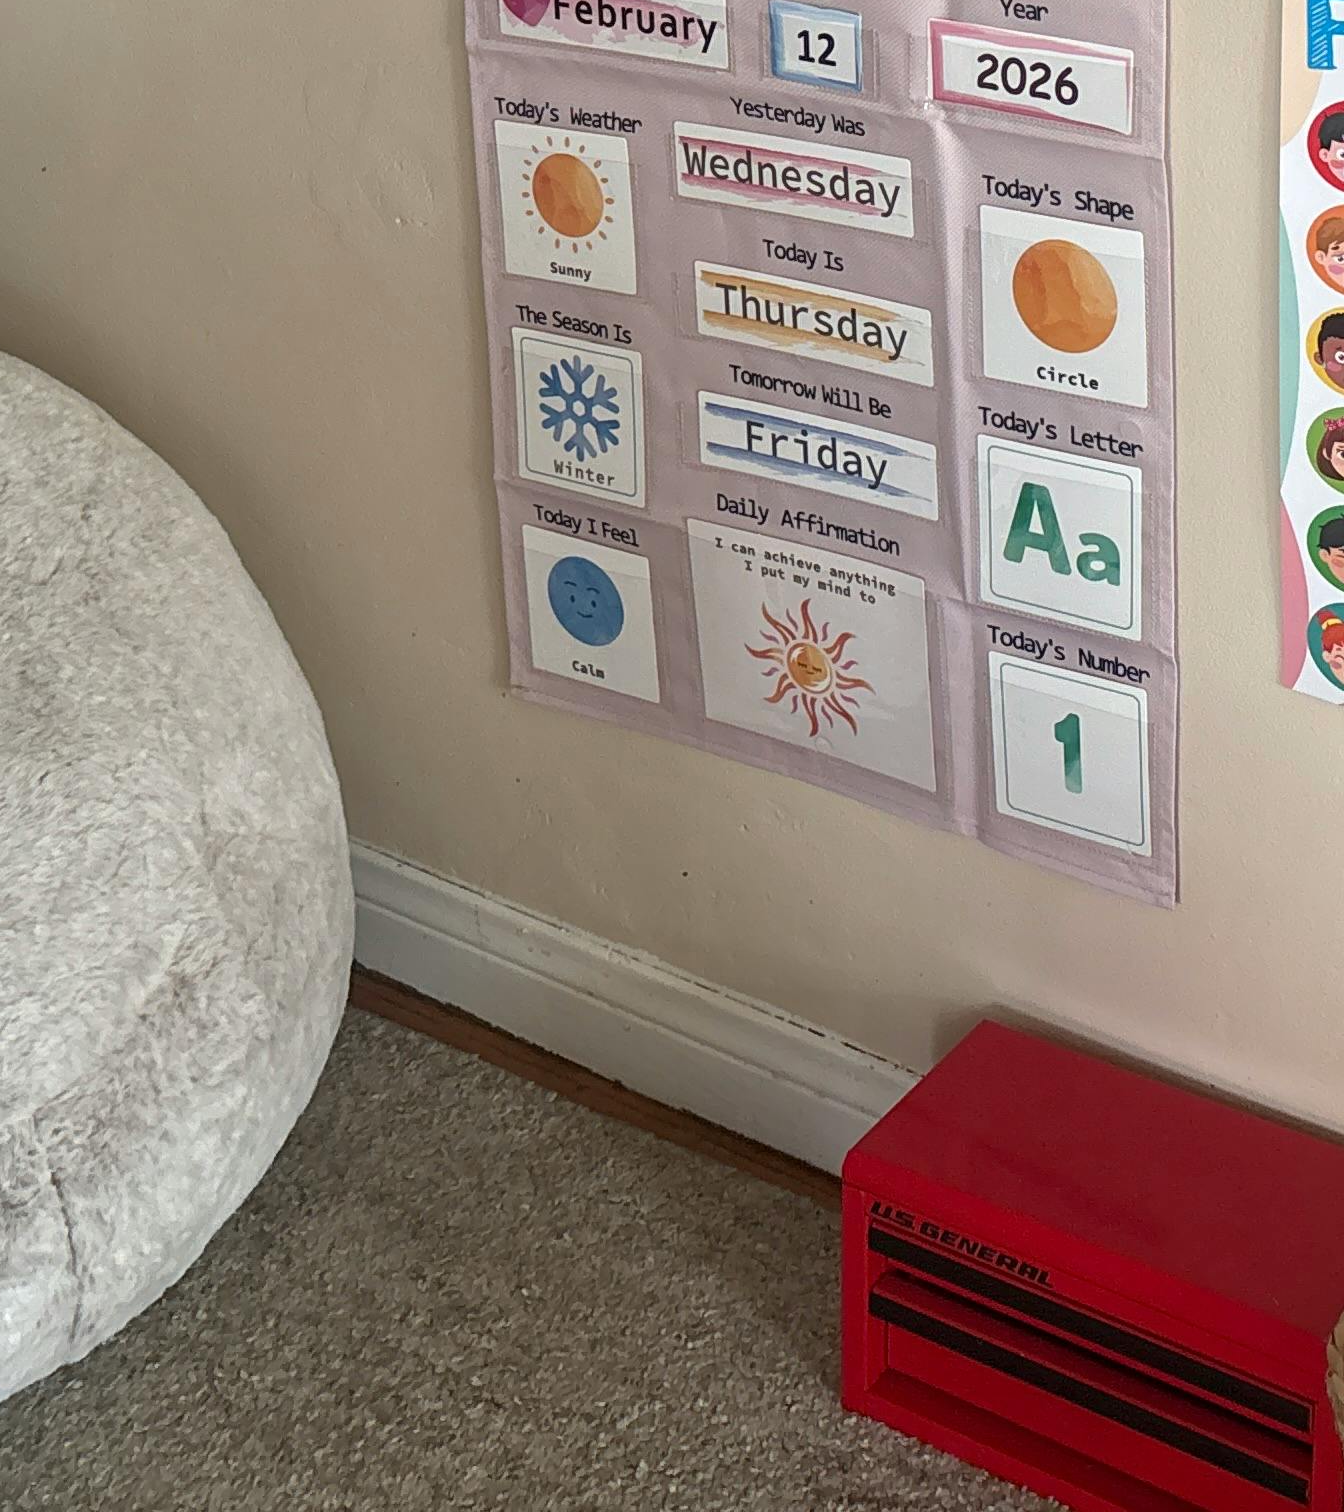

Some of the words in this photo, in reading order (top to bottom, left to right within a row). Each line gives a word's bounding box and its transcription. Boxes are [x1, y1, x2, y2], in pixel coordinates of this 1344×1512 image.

[797, 29, 837, 67] 12
[976, 53, 1080, 106] 2026
[494, 97, 560, 124] Today's
[569, 106, 642, 133] Weather
[730, 98, 826, 133] Yesterday
[830, 114, 865, 136] Was
[683, 141, 901, 217] Wednesday
[982, 175, 1061, 207] Today's
[1075, 191, 1134, 220] Shape
[550, 262, 592, 282] Sunny
[763, 239, 817, 268] Today
[824, 251, 844, 272] Is
[515, 305, 547, 326] The
[552, 312, 608, 339] Season
[613, 325, 632, 344] Is
[716, 283, 907, 360] Thursday
[729, 365, 816, 401] Tomorrow
[821, 385, 862, 410] Will
[869, 397, 892, 418] Be
[1037, 367, 1099, 390] Circle
[746, 421, 888, 490] Friday
[978, 406, 1057, 439] Today's
[1071, 426, 1143, 457] Letter
[553, 459, 615, 487] Winter
[533, 504, 582, 533] Today
[587, 517, 598, 535] I
[601, 522, 638, 547] Feel
[716, 493, 769, 525] Daily
[781, 510, 900, 557] Affirmation
[1003, 482, 1120, 586] Aa
[715, 538, 723, 549] I
[731, 542, 755, 557] can
[764, 549, 821, 574] achieve
[829, 565, 896, 596] anything
[745, 560, 753, 571] I
[761, 565, 785, 582] put
[793, 574, 810, 589] my
[818, 578, 852, 598] mind
[860, 592, 876, 604] to
[572, 660, 605, 679] Calm
[987, 624, 1065, 661] Today's
[1078, 649, 1150, 683] Number
[1054, 713, 1082, 794] 1
[919, 1221, 1054, 1287] GENERAL
